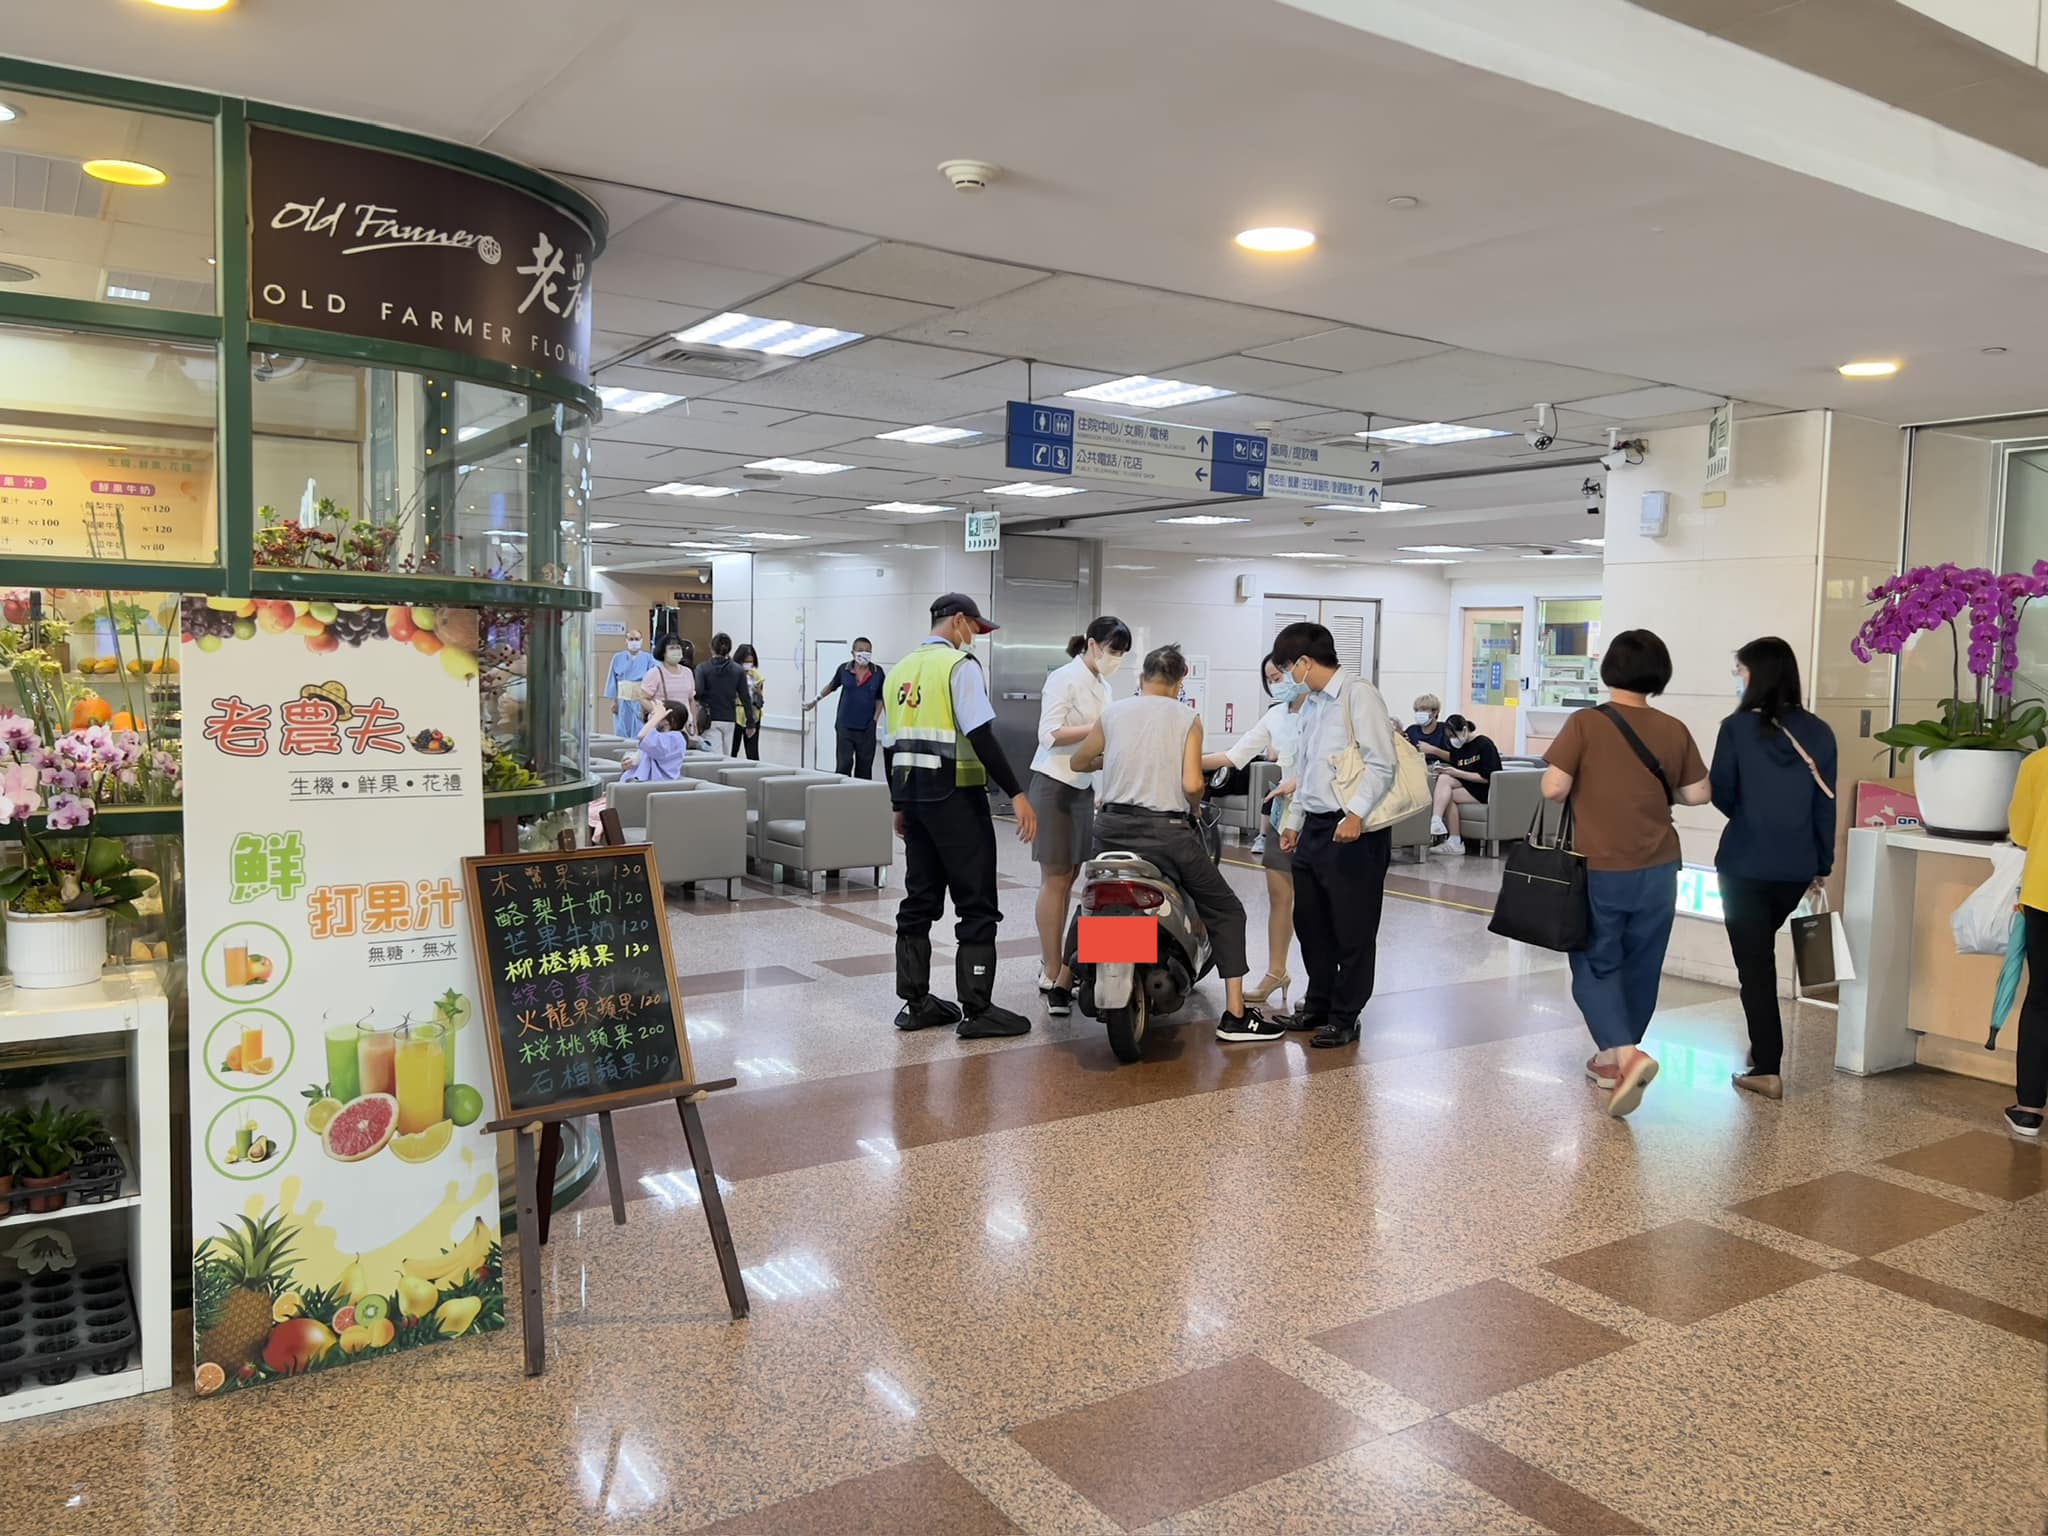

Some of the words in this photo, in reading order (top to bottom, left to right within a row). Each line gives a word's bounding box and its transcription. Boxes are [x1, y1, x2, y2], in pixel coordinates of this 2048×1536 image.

[271, 197, 347, 237] Old
[354, 204, 488, 247] Farmer
[263, 284, 346, 314] OLD
[381, 302, 512, 345] FARMER
[897, 682, 921, 708] G4S
[203, 695, 405, 757] 老農夫
[612, 864, 642, 881] 130
[307, 878, 465, 939] 打果汁
[494, 889, 612, 928] 酪梨牛奶
[503, 920, 615, 956] 芒果牛奶
[622, 919, 649, 936] 120
[504, 944, 615, 983] 柳橙蘋果
[625, 943, 650, 958] 130
[511, 973, 617, 1007] 綜合果汁
[516, 993, 637, 1038] 火龍果蘋果
[639, 994, 662, 1010] 120
[638, 1024, 665, 1040] 200
[526, 1052, 641, 1096] 石榴蘋果
